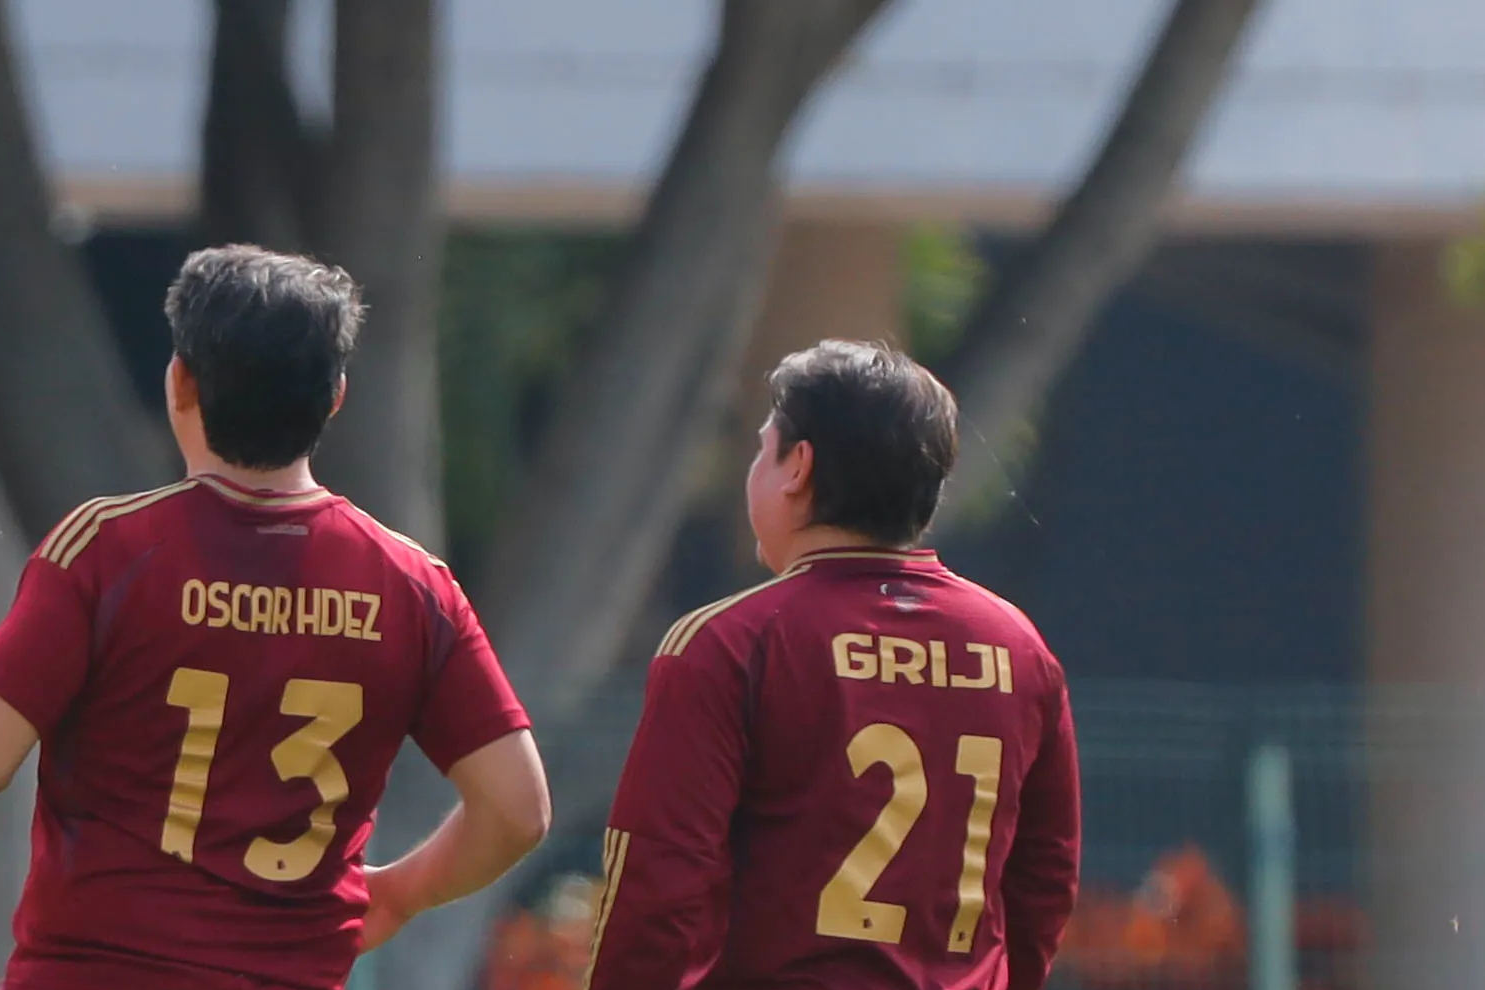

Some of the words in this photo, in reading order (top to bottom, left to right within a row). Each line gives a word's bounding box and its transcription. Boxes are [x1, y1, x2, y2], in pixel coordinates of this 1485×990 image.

[180, 578, 291, 635] OSCAR
[297, 587, 383, 642] HDEZ
[831, 632, 1013, 694] GRIJI
[160, 666, 364, 882] 13
[815, 722, 1003, 953] 21
